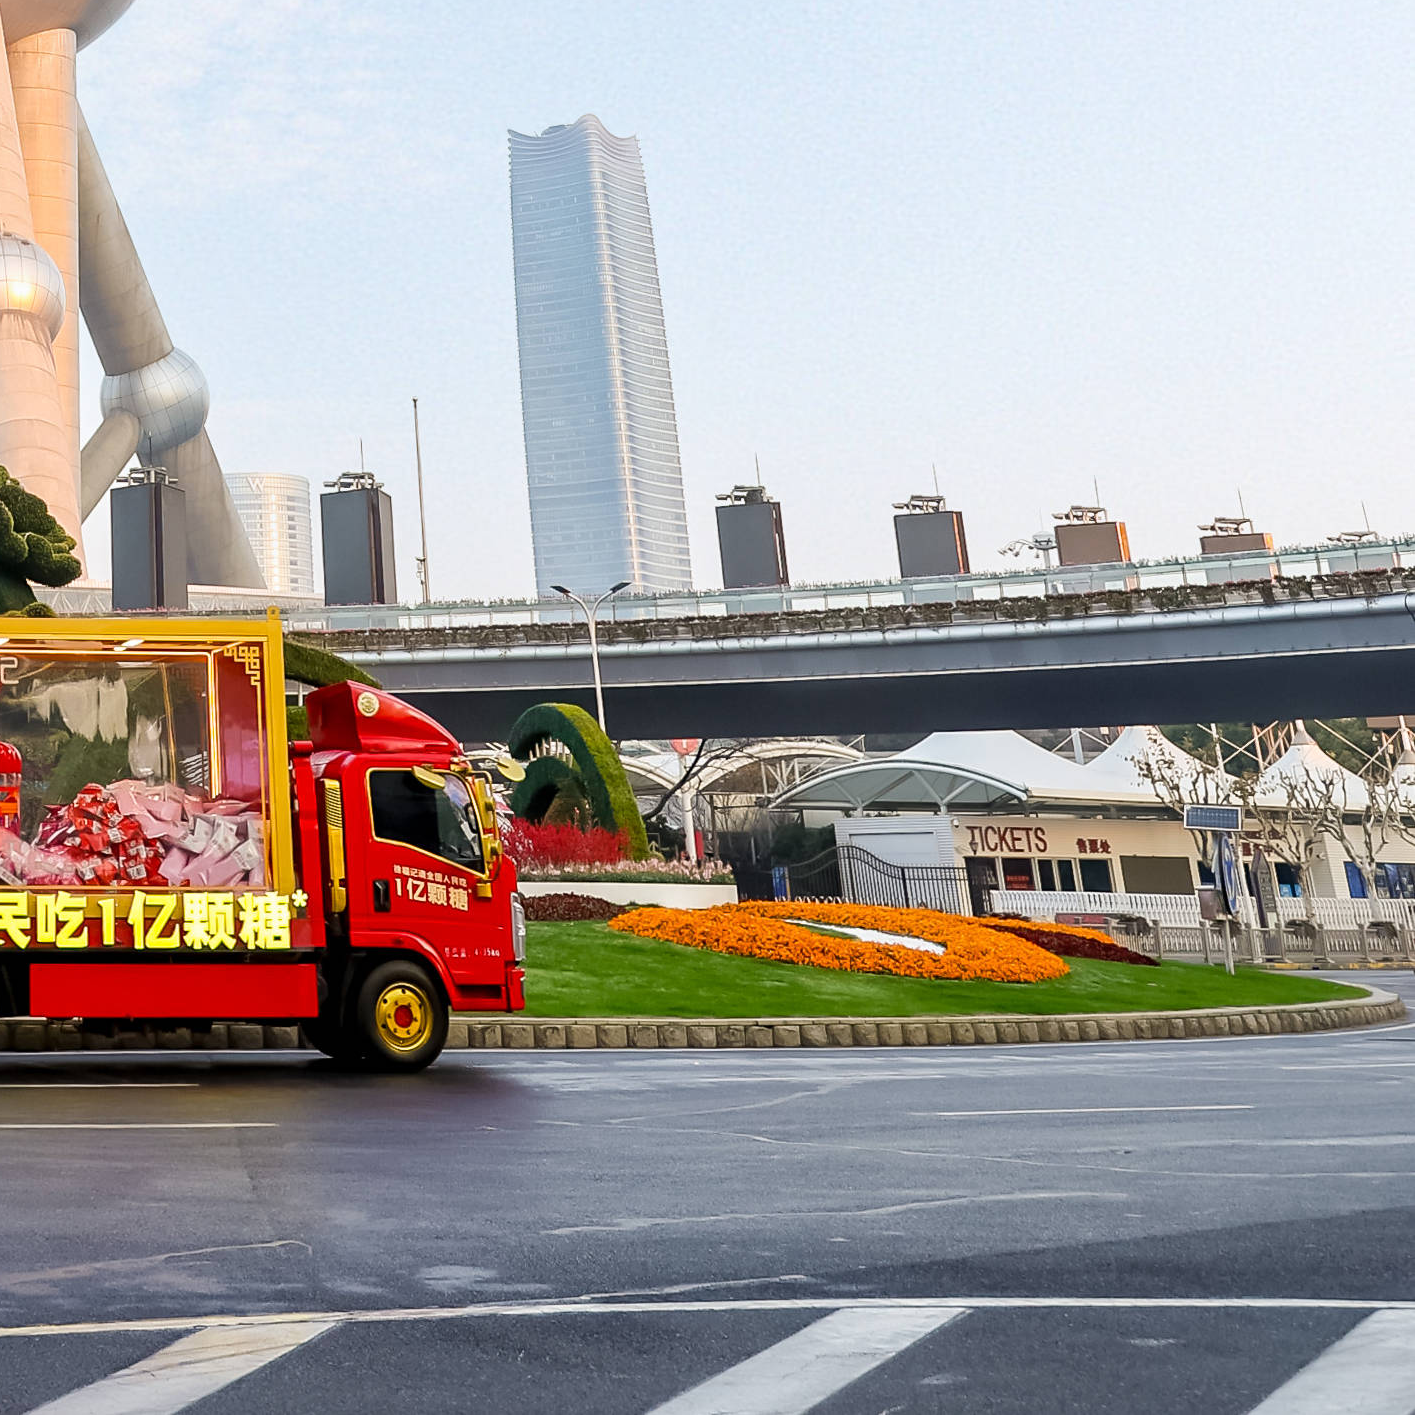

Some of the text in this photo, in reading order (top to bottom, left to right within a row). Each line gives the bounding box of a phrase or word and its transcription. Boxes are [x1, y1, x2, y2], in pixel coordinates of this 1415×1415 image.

[966, 826, 1048, 853] TICKETS
[1076, 838, 1112, 854] 售票处
